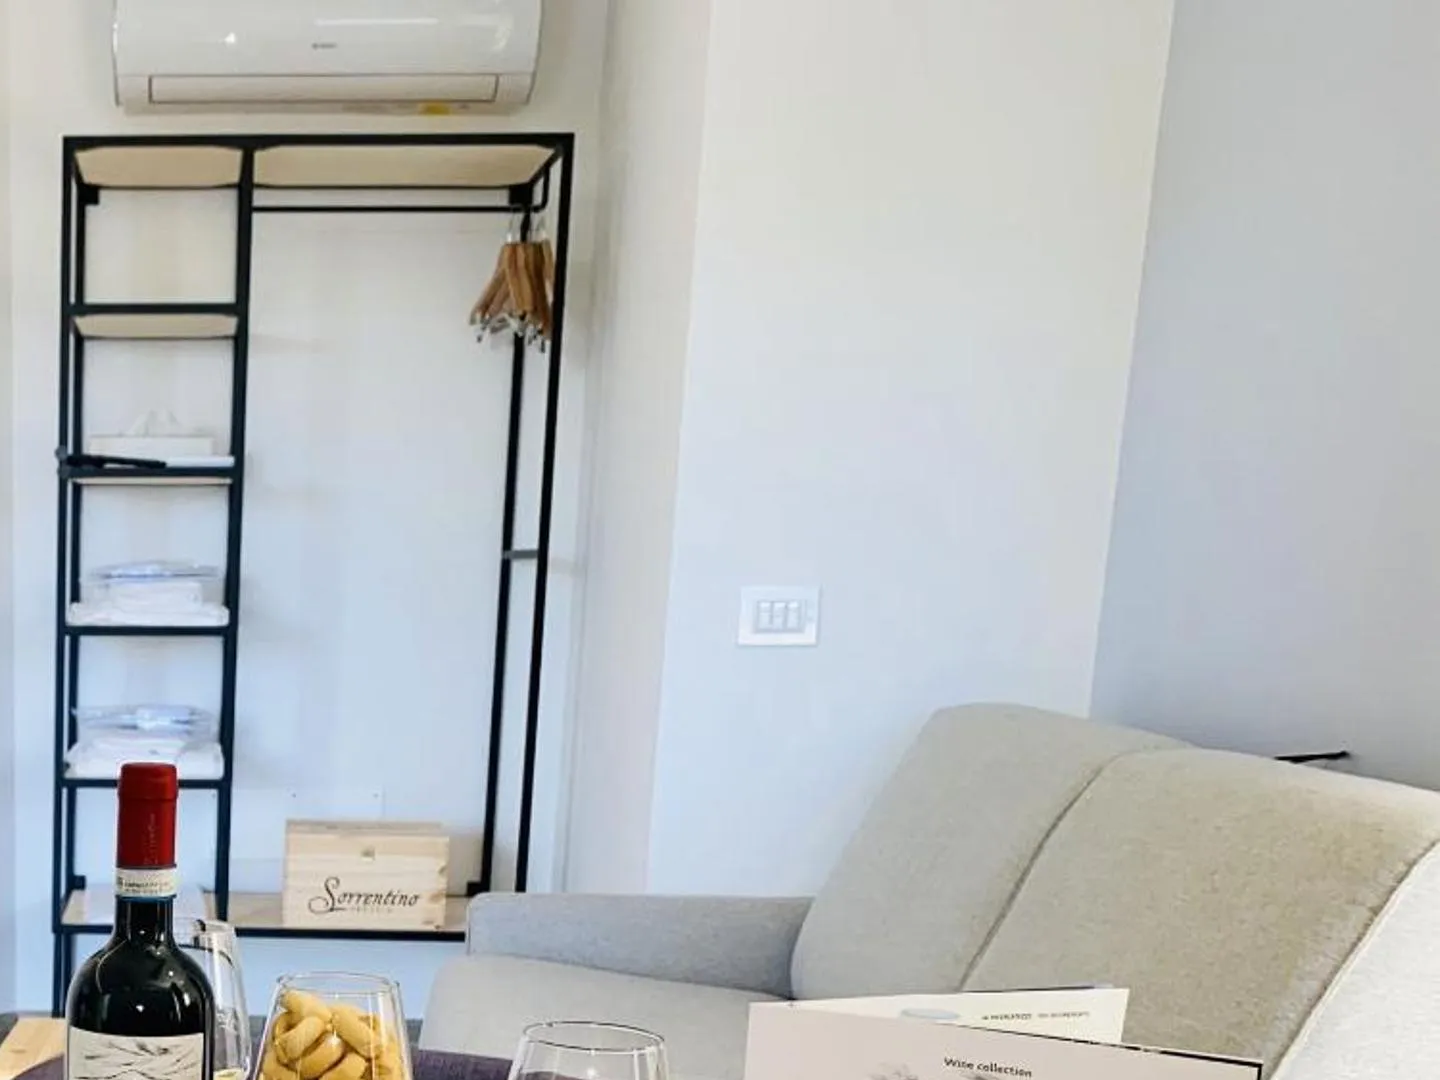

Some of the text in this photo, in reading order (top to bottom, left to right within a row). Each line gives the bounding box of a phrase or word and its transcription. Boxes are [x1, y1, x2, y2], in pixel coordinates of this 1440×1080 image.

[308, 877, 421, 914] Sorrentino
[944, 1057, 1032, 1078] Wine collection
